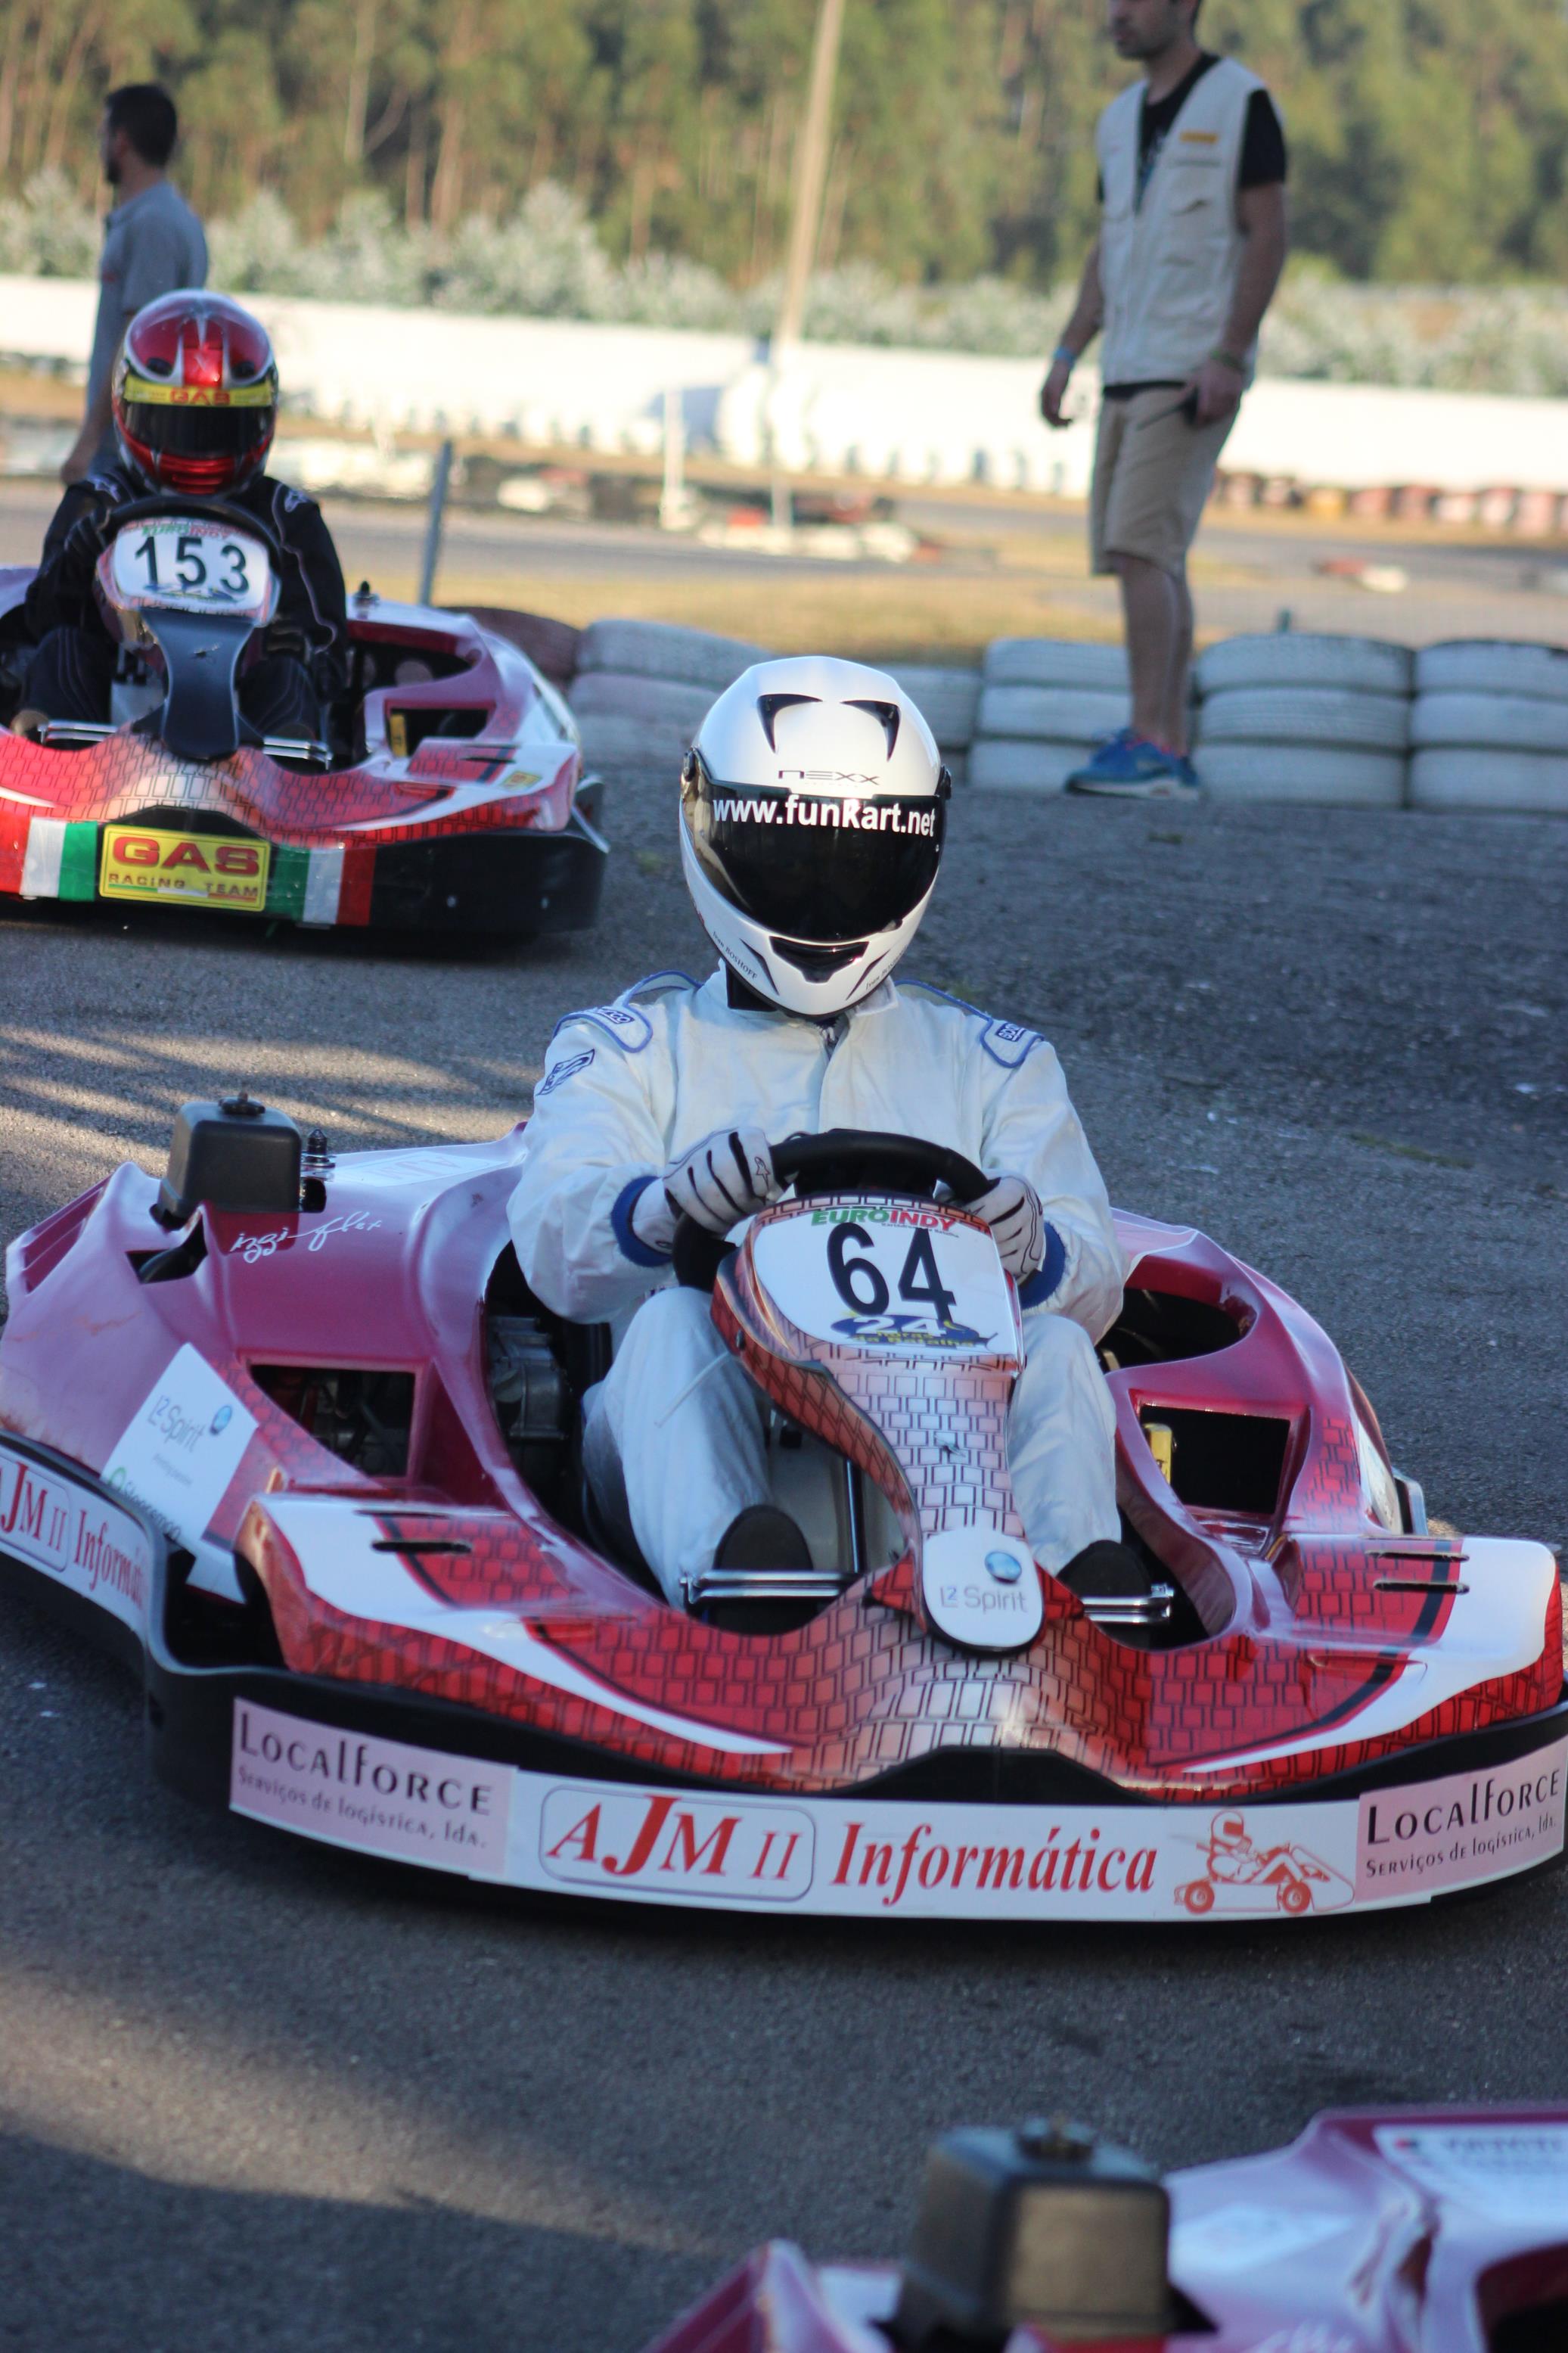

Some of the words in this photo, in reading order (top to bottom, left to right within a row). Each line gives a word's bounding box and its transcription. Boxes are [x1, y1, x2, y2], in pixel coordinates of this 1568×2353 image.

[135, 536, 250, 594] 153
[108, 872, 185, 888] RACING
[205, 883, 258, 897] TEAM
[113, 837, 259, 876] GAS
[811, 1208, 957, 1232] EUROINDY
[827, 1221, 957, 1326] 64
[0, 1460, 48, 1540] JM
[964, 1586, 1028, 1615] Spirit
[545, 1794, 743, 1877] AJM
[750, 1830, 803, 1881] II
[830, 1822, 1158, 1907] Informática
